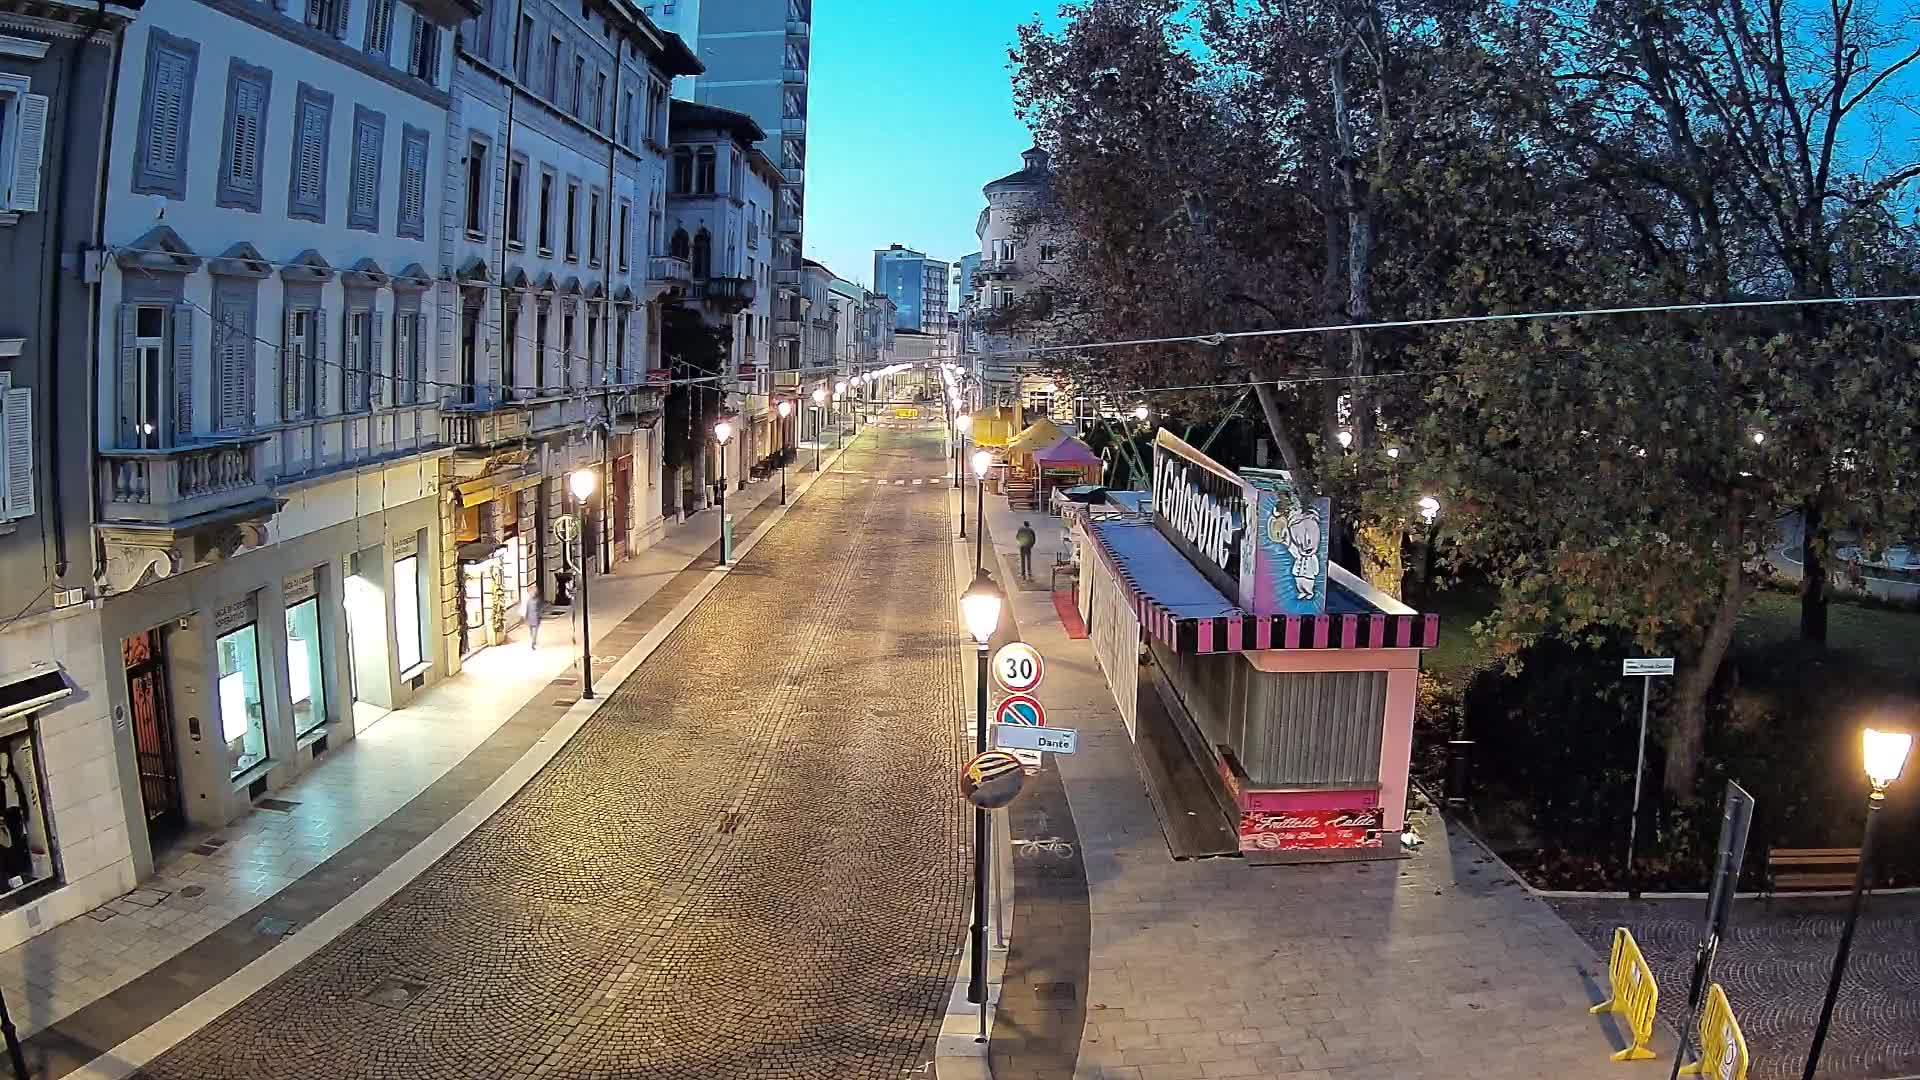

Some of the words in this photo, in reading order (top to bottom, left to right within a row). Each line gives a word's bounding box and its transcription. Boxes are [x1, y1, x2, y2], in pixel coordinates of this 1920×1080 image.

[1161, 458, 1232, 569] Golosone
[1006, 658, 1033, 680] 30
[1038, 737, 1070, 750] Dante
